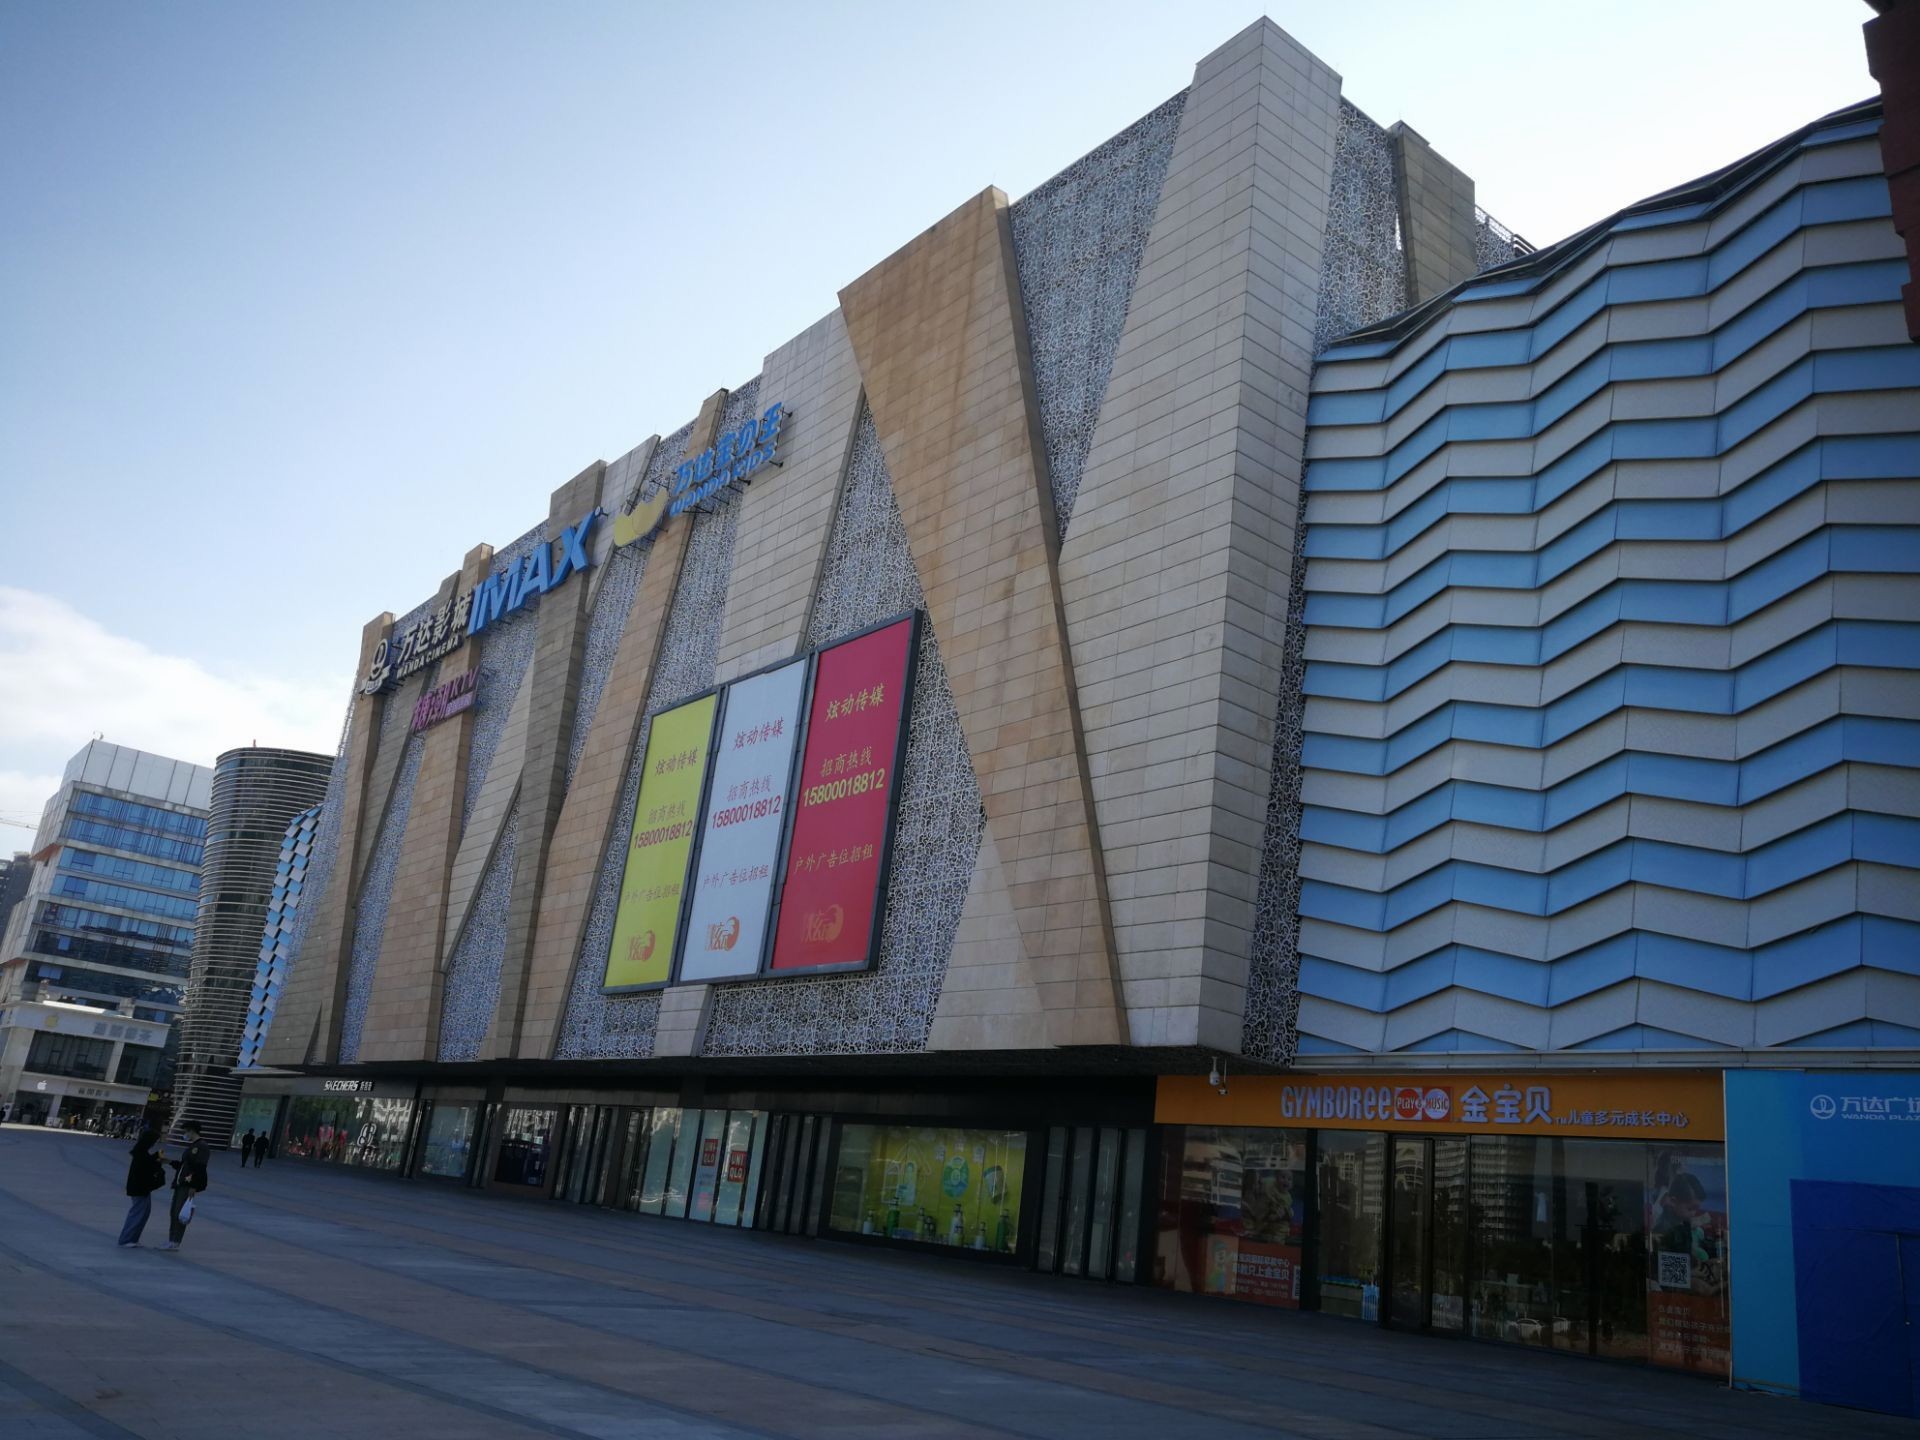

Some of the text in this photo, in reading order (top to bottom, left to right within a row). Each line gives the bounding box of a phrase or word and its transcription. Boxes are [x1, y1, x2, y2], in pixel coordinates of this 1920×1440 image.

[467, 509, 597, 637] IMAX
[397, 592, 473, 664] 万达影城
[397, 635, 459, 680] WANDA CINEMA
[825, 683, 885, 722] 炫动传媒
[733, 718, 784, 751] 炫动传媒
[655, 747, 698, 776] 炫动传媒
[820, 746, 872, 777] 招商热线
[727, 775, 772, 801] 招商热线
[803, 768, 885, 808] 15800018812
[712, 795, 781, 830] 15800018812
[633, 820, 693, 849] 15800018812
[793, 844, 873, 875] 户外广告位招租
[702, 865, 769, 890] 户外广告位招租
[323, 1080, 359, 1091] SKECHERS
[1460, 1083, 1553, 1124] 金宝贝
[1568, 1108, 1689, 1129] 儿童多元成长中心
[1841, 1113, 1886, 1121] WANDA
